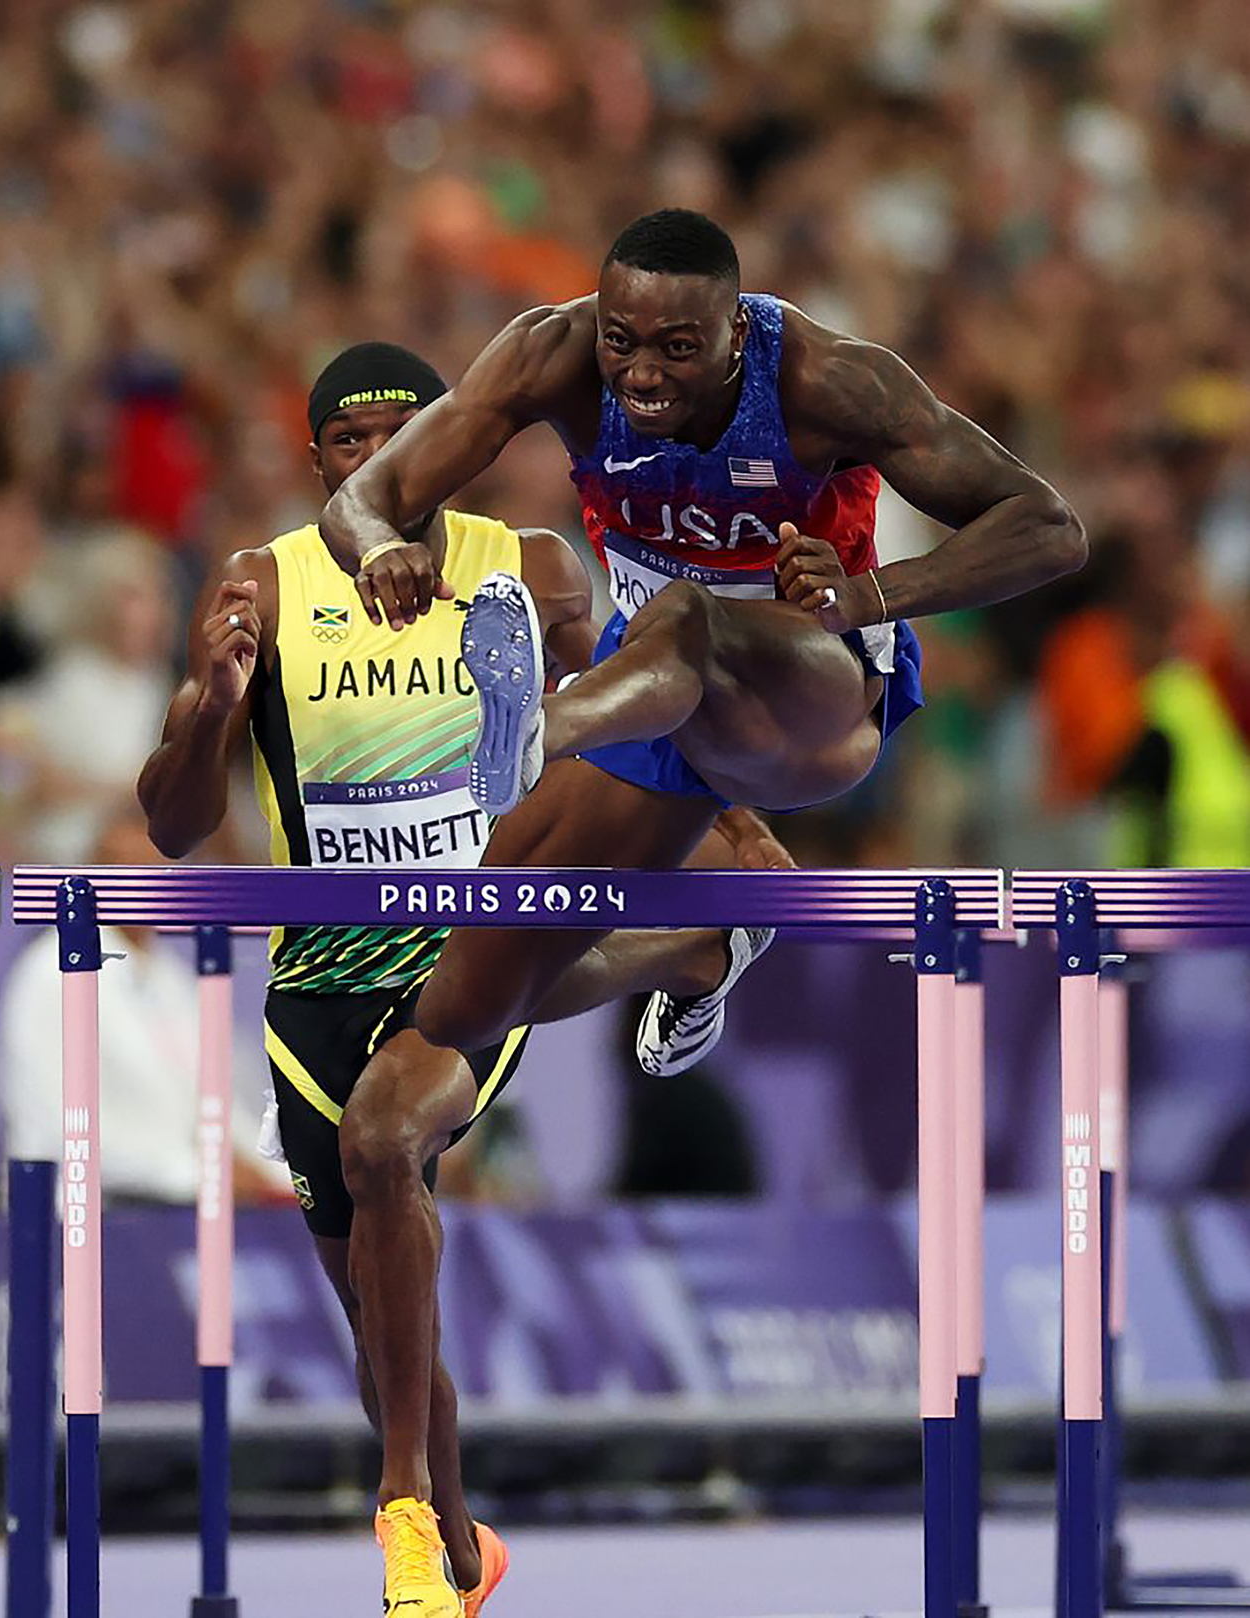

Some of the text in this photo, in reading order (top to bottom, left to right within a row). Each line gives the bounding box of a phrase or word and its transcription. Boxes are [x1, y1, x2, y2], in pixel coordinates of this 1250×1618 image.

[621, 498, 779, 551] USA
[640, 550, 678, 574] PARIS
[308, 657, 475, 702] JAMAIC
[348, 779, 439, 799] PARIS 2024
[314, 808, 483, 864] BENNETT
[517, 884, 625, 912] 2024
[65, 1139, 90, 1248] MONDO
[1065, 1145, 1091, 1254] MONDO
